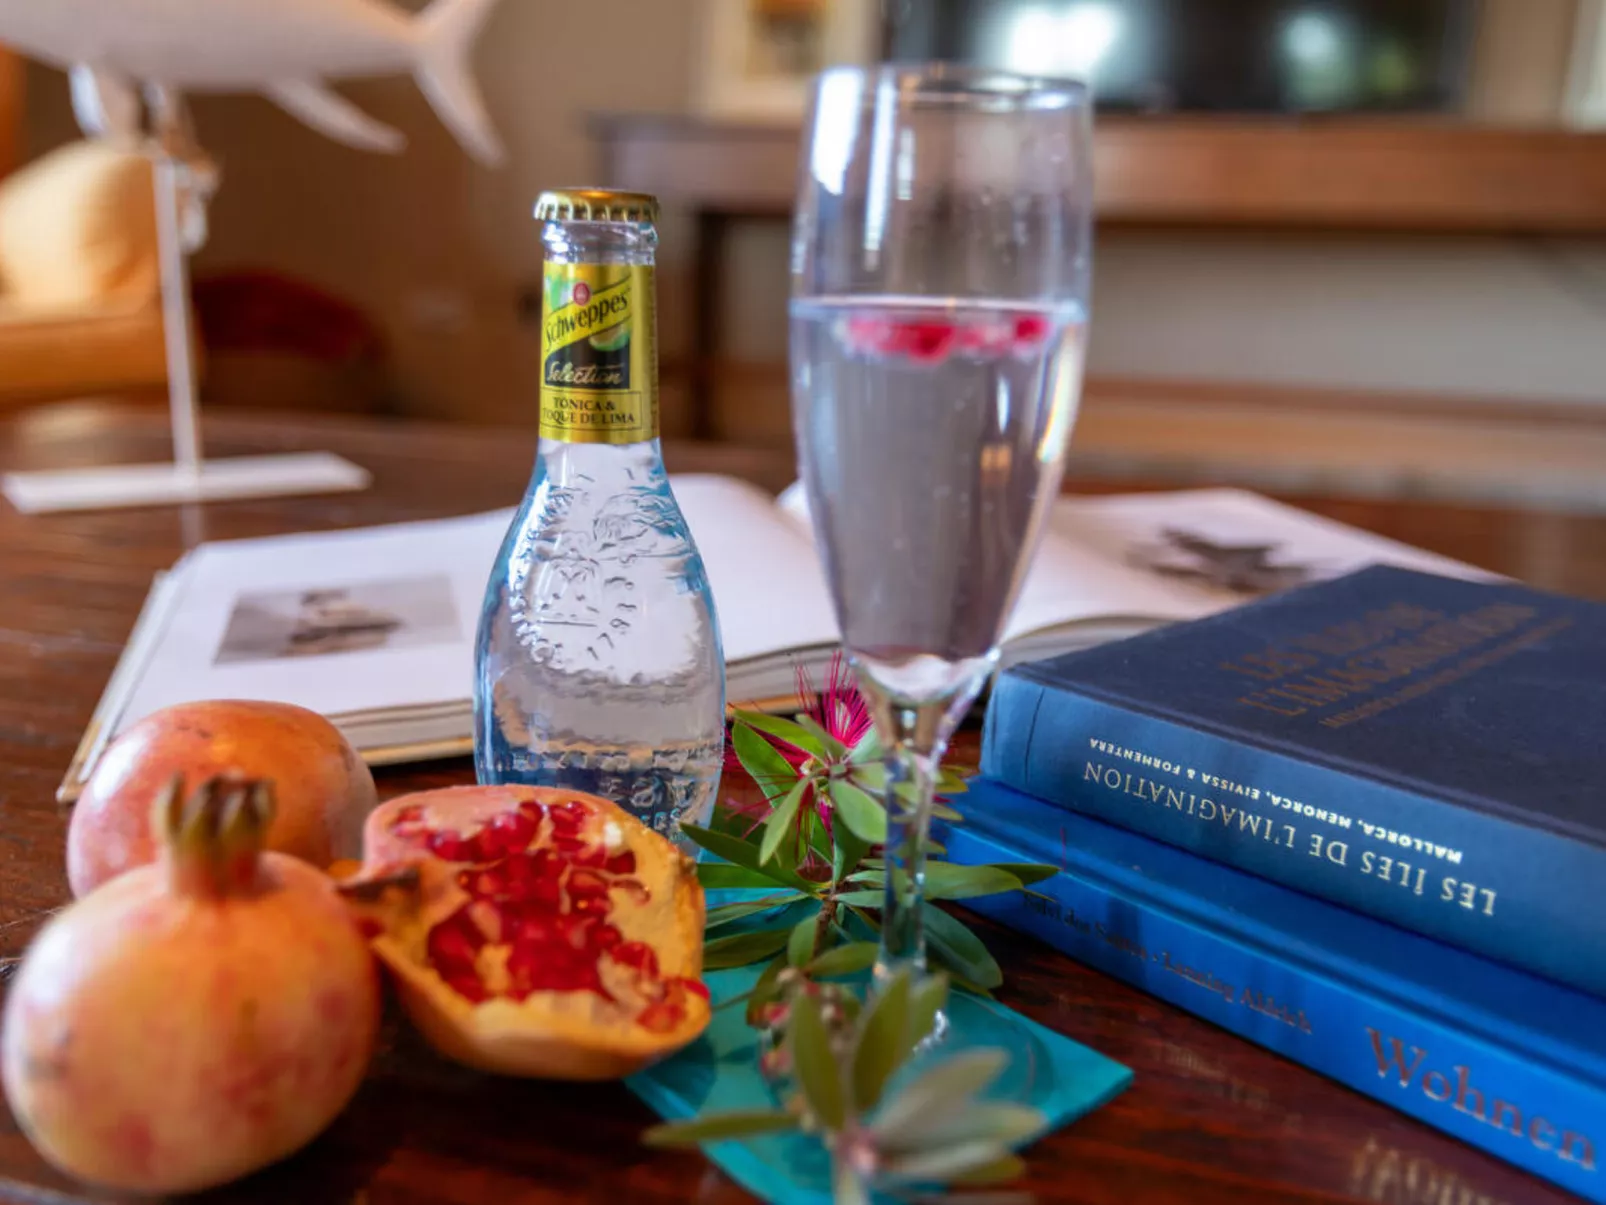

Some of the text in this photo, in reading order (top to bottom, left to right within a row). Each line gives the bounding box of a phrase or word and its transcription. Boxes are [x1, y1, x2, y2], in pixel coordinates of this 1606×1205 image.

[546, 292, 629, 353] Schweppes
[547, 360, 624, 385] Selection
[542, 407, 635, 425] TOQUE DE LIMA
[605, 400, 616, 411] &
[1089, 736, 1465, 866] MALLORCA, MENORCA, EIVISSA & FORMENTERA
[1082, 760, 1498, 917] LES ÎLES DE L'IMAGINATION
[1364, 1025, 1596, 1171] Wohnen
